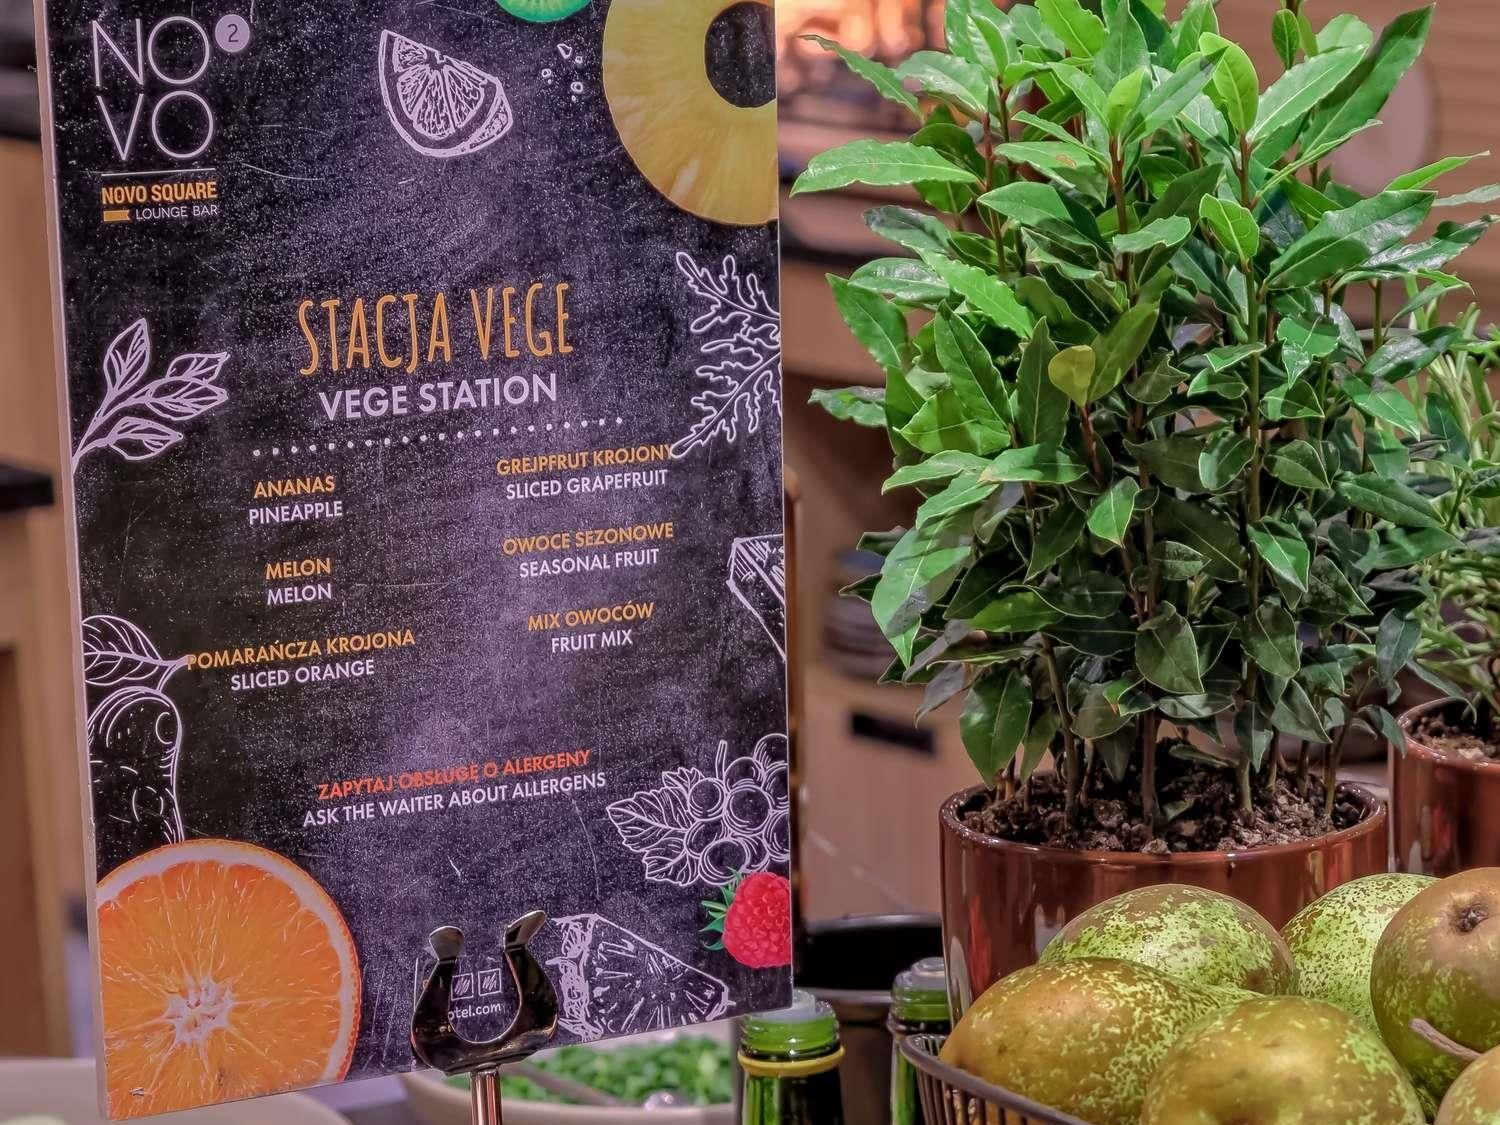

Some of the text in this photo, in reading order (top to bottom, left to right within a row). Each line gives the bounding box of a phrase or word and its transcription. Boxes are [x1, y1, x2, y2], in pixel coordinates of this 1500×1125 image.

[92, 16, 210, 87] NO
[96, 90, 214, 161] VO
[102, 181, 219, 205] NOVO SQUARE
[136, 205, 219, 221] LOUNGE BAR
[298, 282, 573, 375] STACJA VEGE
[318, 373, 558, 422] VEGE STATION
[496, 444, 674, 476] GREJPFRUT KROJONY
[253, 475, 336, 499] ANANAS
[506, 469, 669, 500] SLICED GRAPEFRUIT
[249, 501, 343, 526] PINEAPPLE
[502, 521, 674, 557] OWOCE SEZONOWE
[265, 557, 332, 580] MELON
[519, 548, 660, 578] SEASONAL FRUIT
[266, 583, 332, 606] MELON
[527, 600, 655, 632] MIX OWOCÓW
[187, 628, 416, 672] POMARAŃCZA KROJONA
[551, 629, 633, 653] FRUIT MIX
[230, 659, 375, 691] SLICED ORANGE
[317, 775, 393, 801] ZAPYTAJ
[483, 762, 498, 779] O
[504, 749, 592, 777] ALERGENY
[303, 772, 607, 828] ASK THE WAITER ABOUT ALLERGENS
[448, 1003, 502, 1021] otel.com
